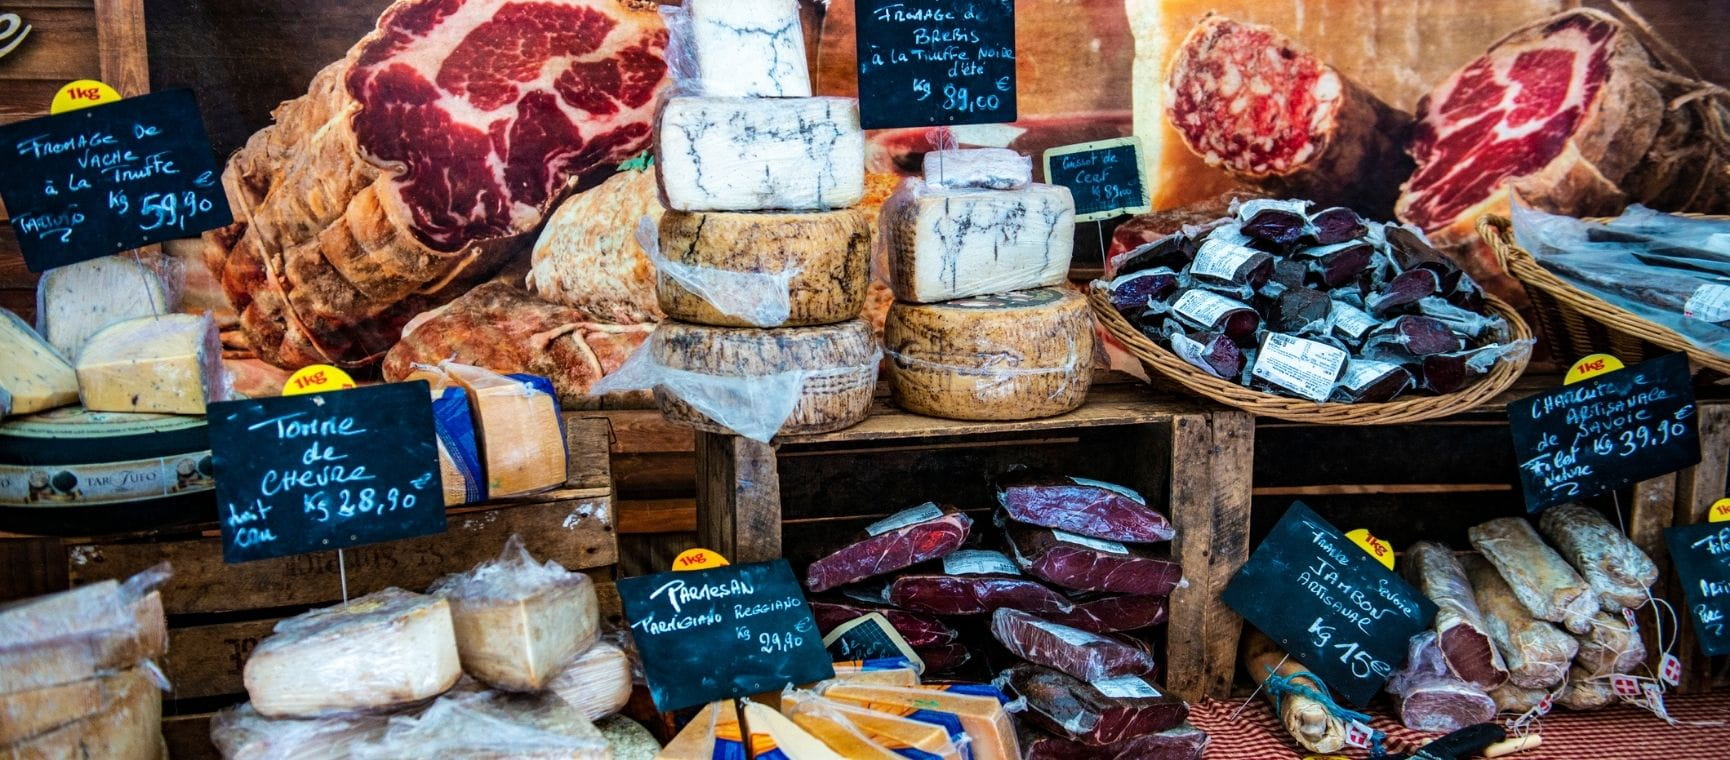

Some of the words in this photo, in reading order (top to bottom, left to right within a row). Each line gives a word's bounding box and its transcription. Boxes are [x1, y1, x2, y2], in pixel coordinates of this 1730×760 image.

[67, 87, 101, 100] 1kg
[139, 191, 213, 231] 59,90
[1577, 359, 1605, 374] 1kg
[294, 371, 328, 389] 1kg
[303, 441, 348, 465] de
[679, 552, 707, 567] 1kg
